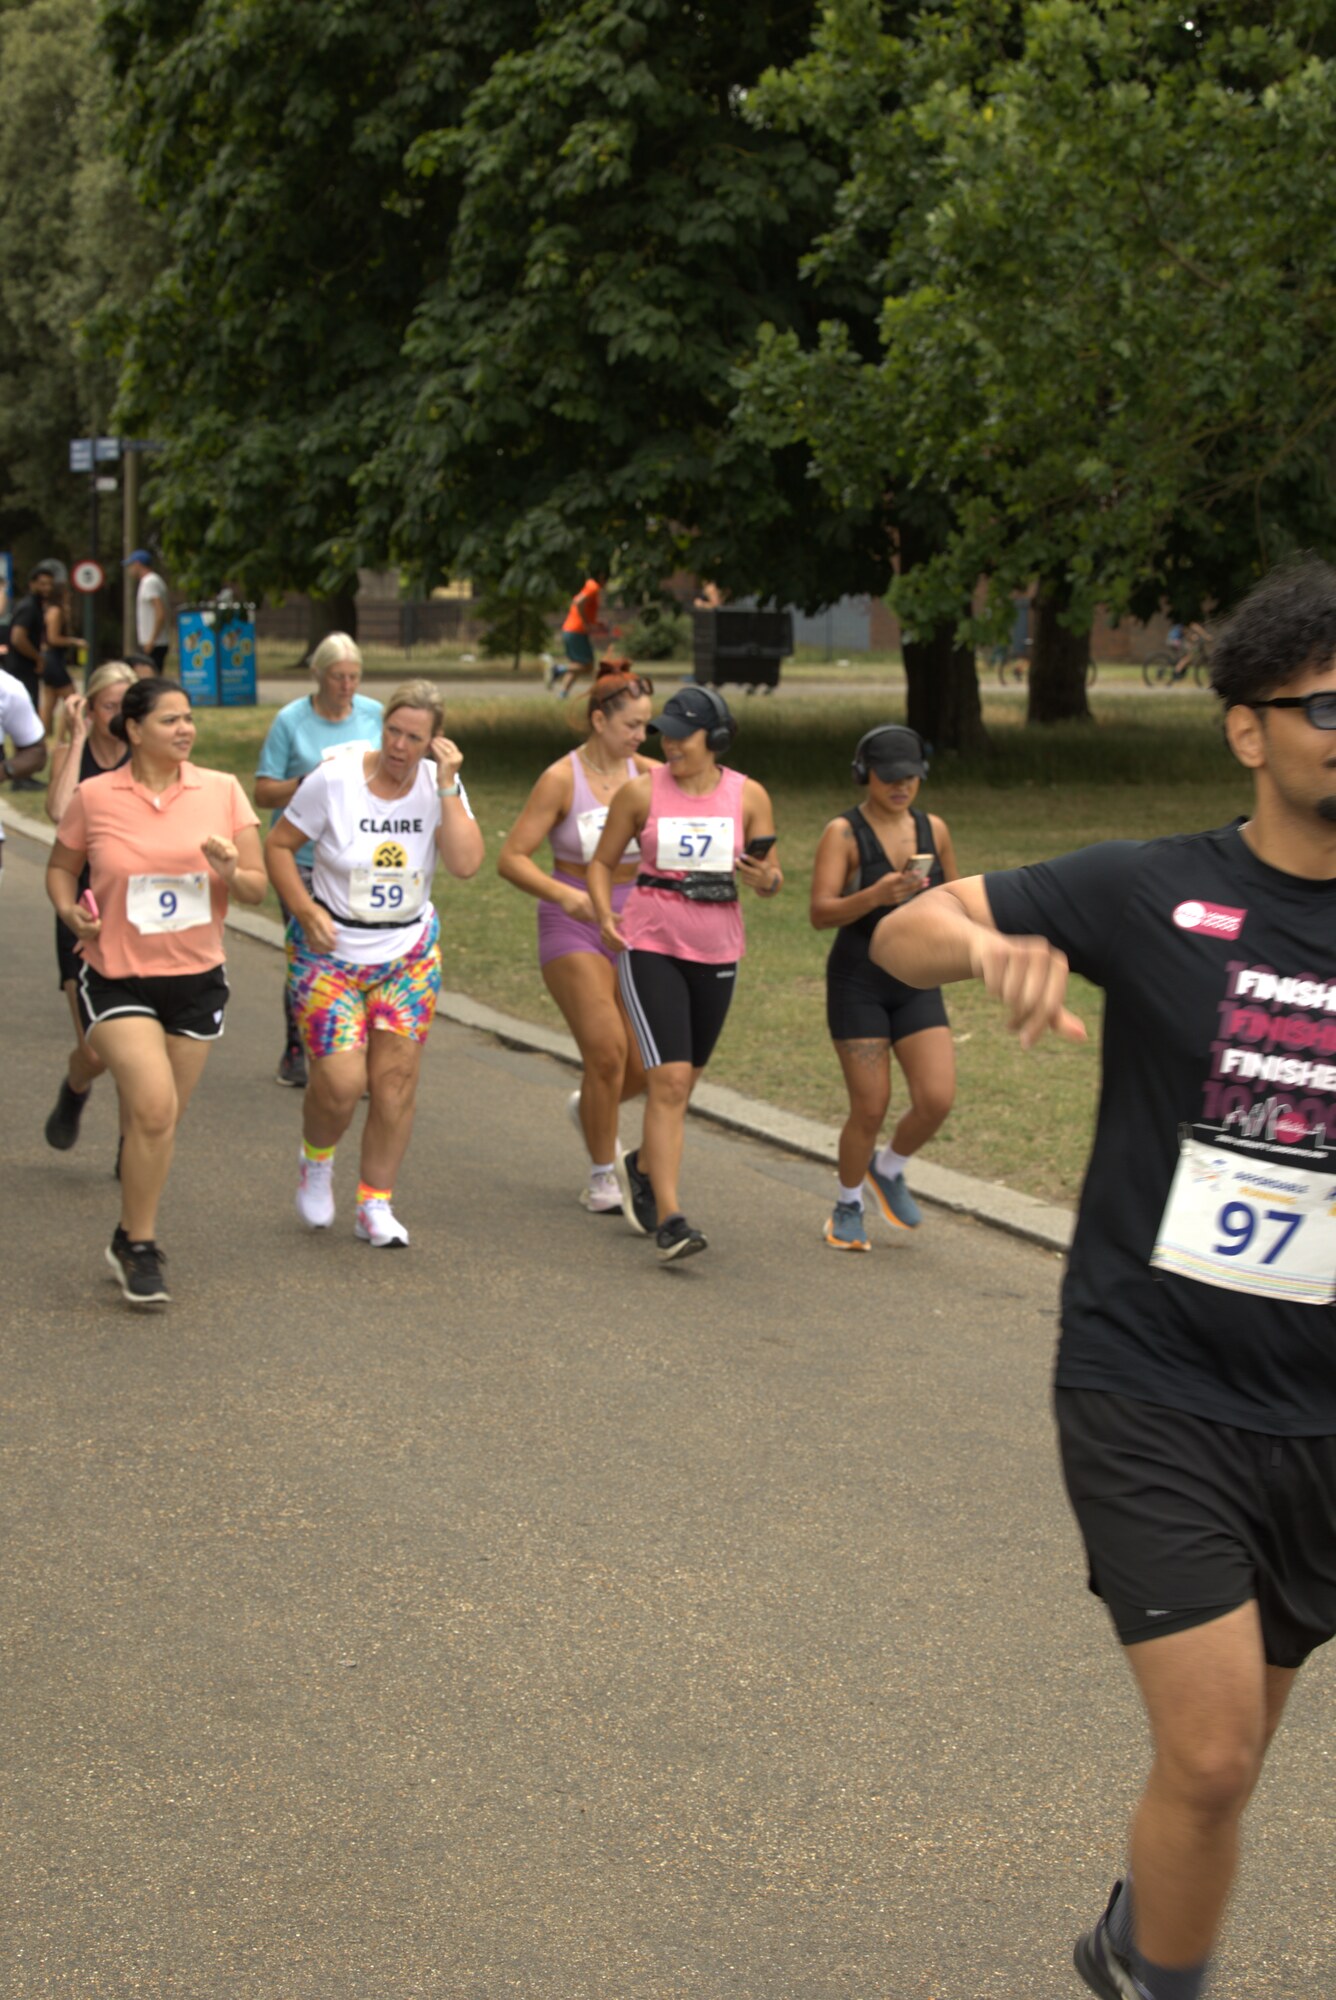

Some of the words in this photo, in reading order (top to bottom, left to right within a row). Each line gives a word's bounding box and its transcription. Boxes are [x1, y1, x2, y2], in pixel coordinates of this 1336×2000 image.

[359, 818, 423, 833] CLAIRE
[678, 835, 712, 858] 57
[159, 890, 177, 918] 9
[370, 884, 404, 908] 59
[1228, 1008, 1336, 1052] FINISH
[1211, 1200, 1305, 1265] 97
